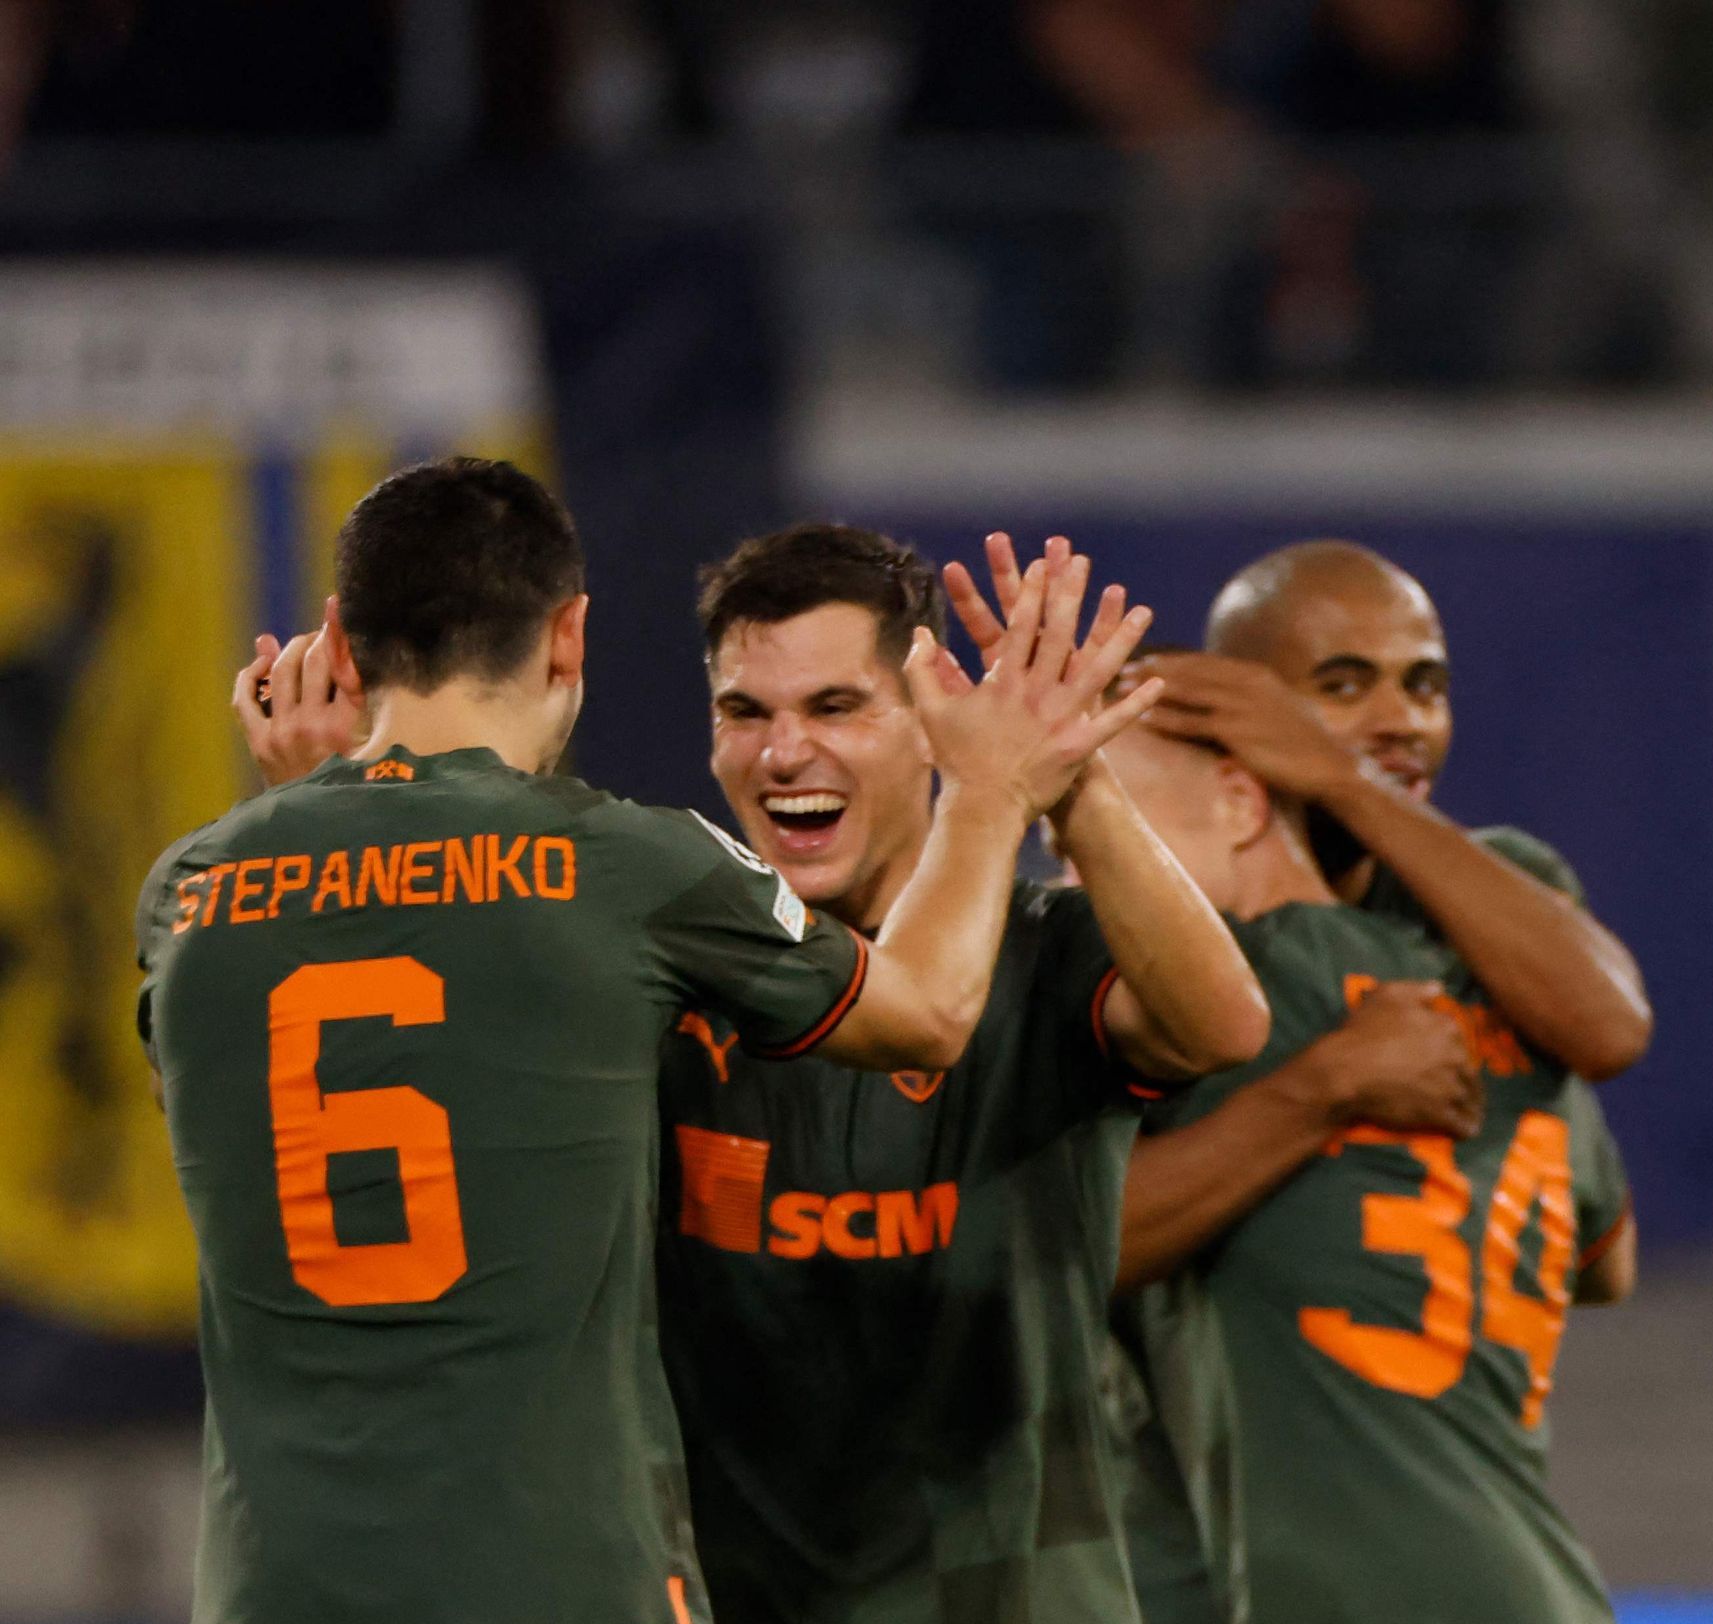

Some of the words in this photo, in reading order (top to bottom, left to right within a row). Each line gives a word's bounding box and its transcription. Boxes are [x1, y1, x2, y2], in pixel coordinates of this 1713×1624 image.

[172, 834, 578, 935] STEPANENKO
[268, 956, 468, 1306] 6
[768, 1180, 959, 1260] SCM
[1299, 1110, 1577, 1432] 34
